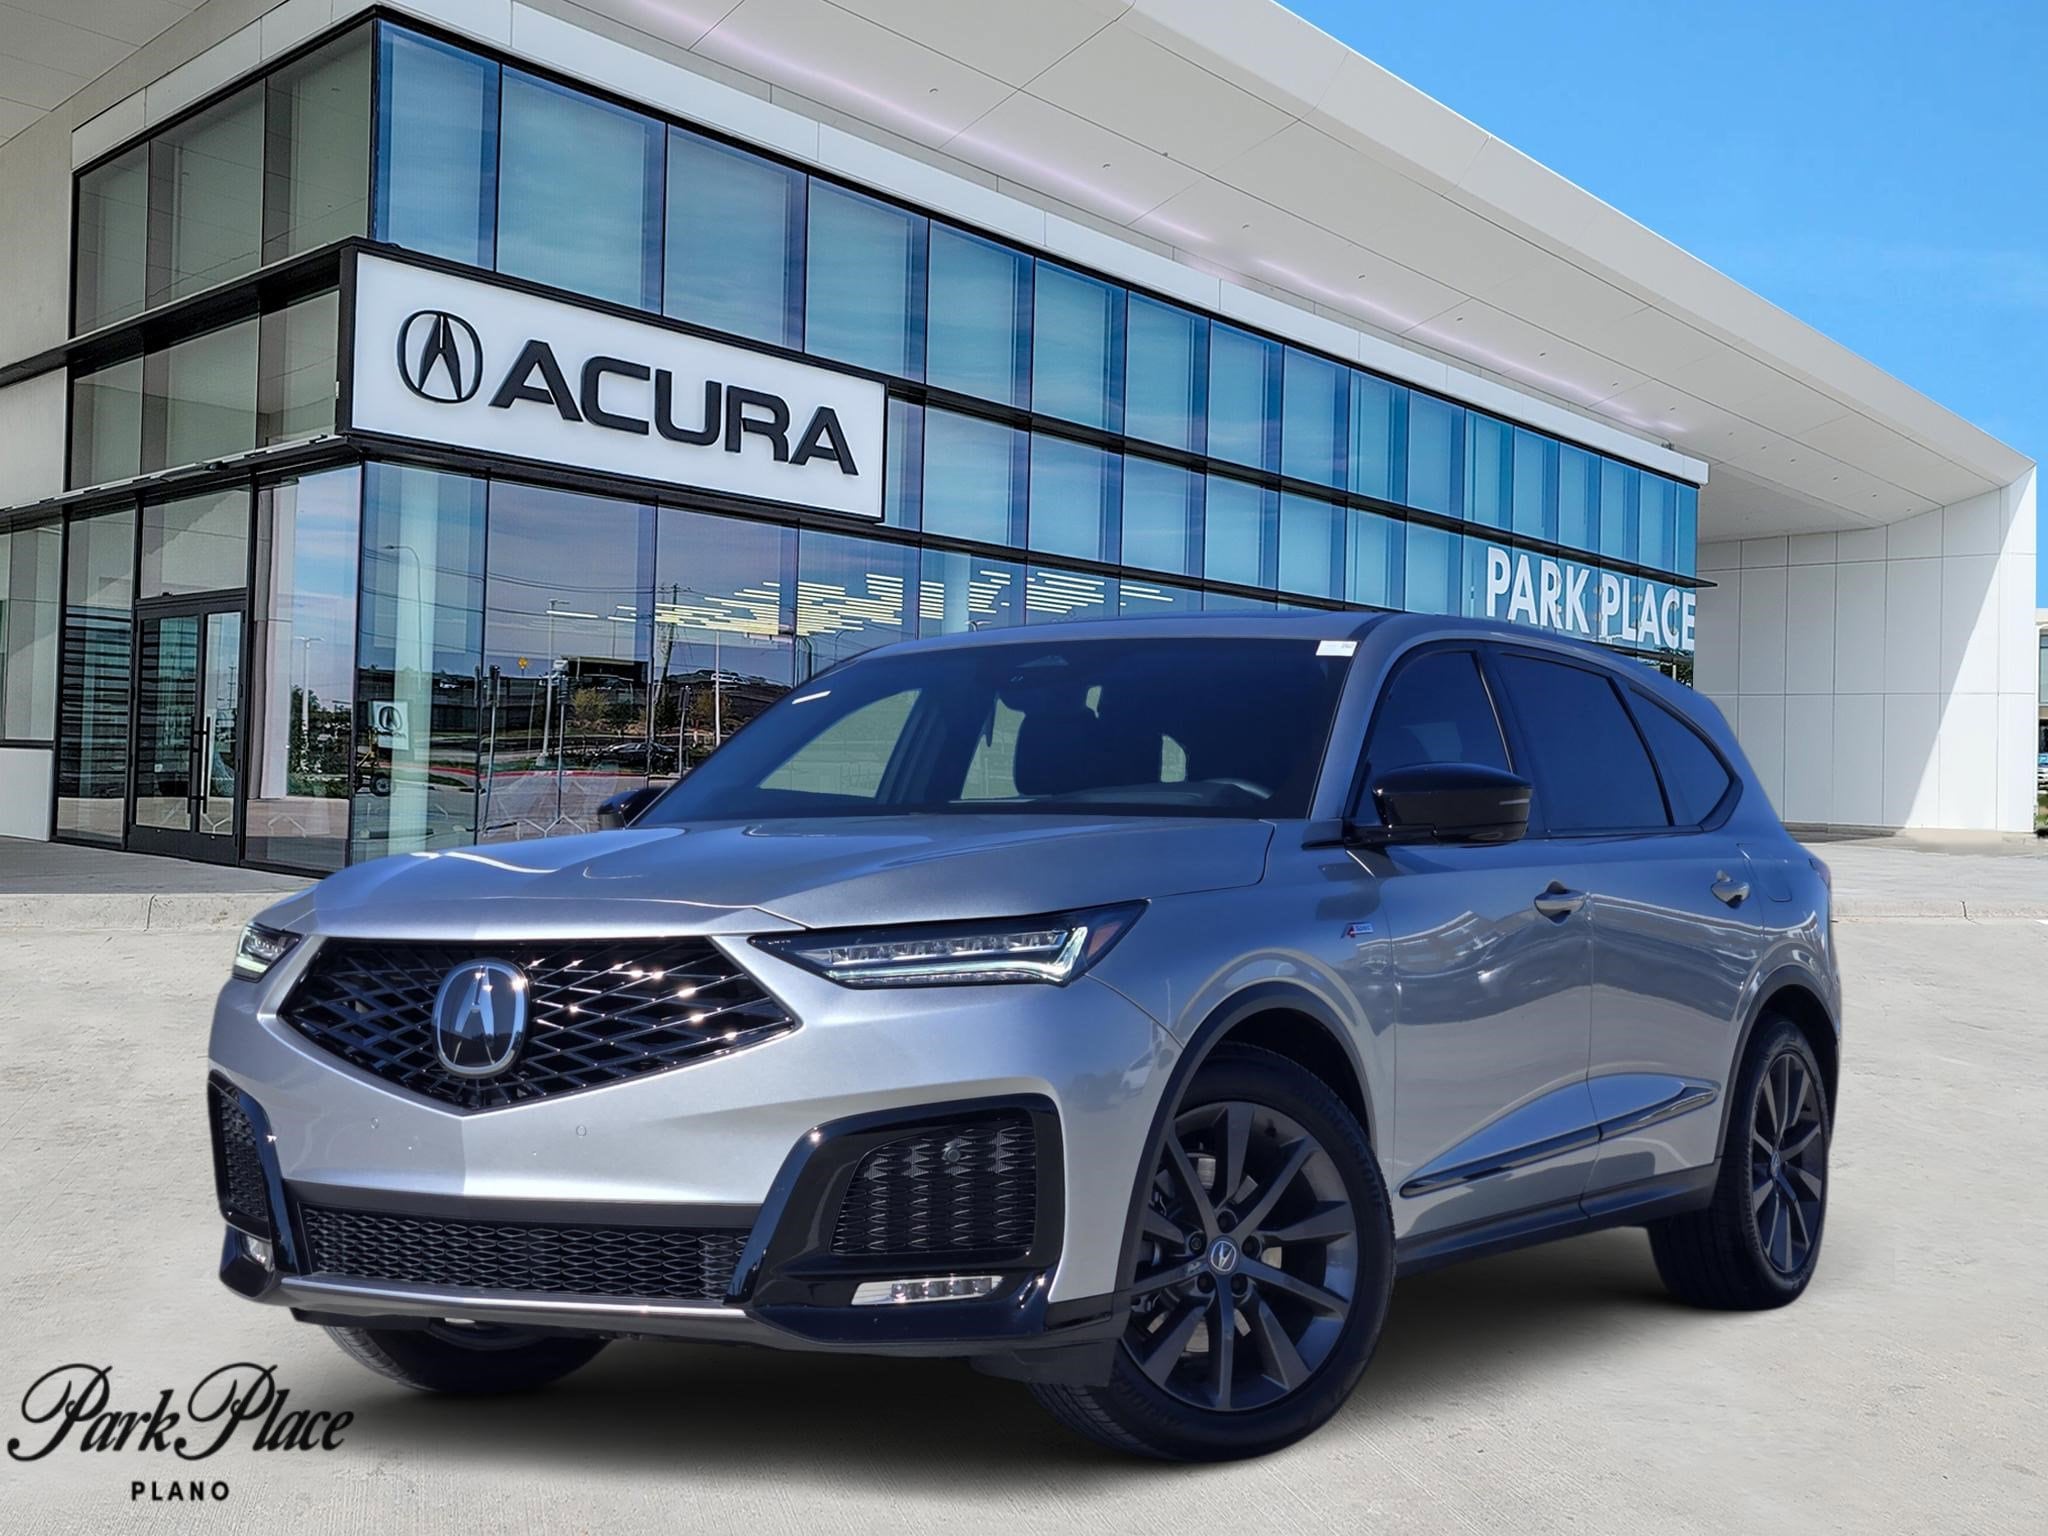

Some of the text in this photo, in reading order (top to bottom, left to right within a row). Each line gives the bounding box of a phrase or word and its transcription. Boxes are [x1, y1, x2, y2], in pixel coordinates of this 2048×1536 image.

[489, 340, 859, 475] ACURA
[1487, 547, 1696, 650] PARK PLACE
